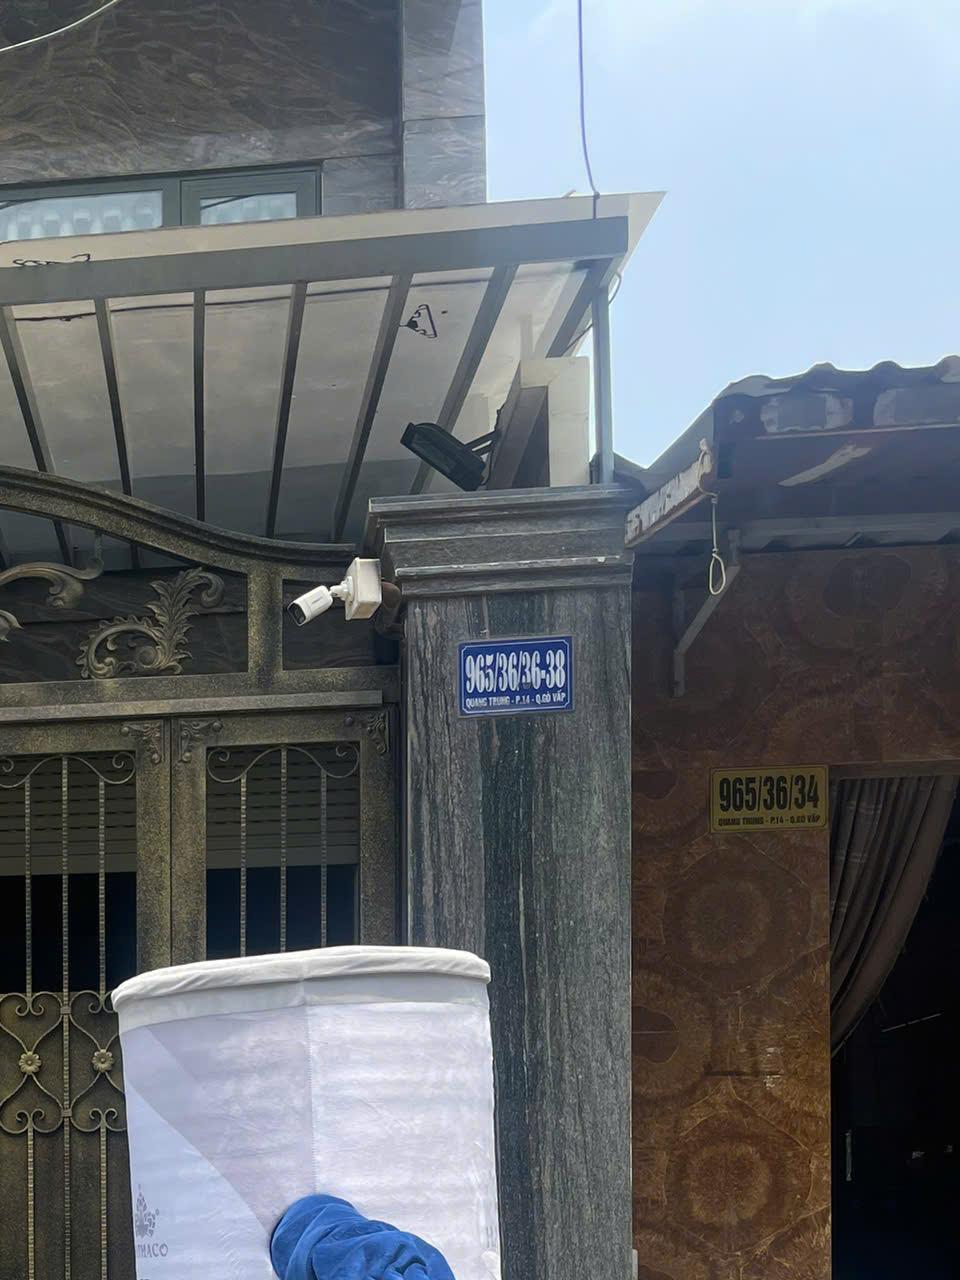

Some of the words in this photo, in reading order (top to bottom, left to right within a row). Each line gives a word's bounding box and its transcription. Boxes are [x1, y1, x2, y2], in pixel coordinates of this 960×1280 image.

[465, 649, 566, 693] 965/36/36-38
[465, 697, 488, 709] QUANG
[488, 696, 510, 706] TRUNG
[552, 689, 566, 702] VẤP
[720, 775, 820, 812] 965/36/34
